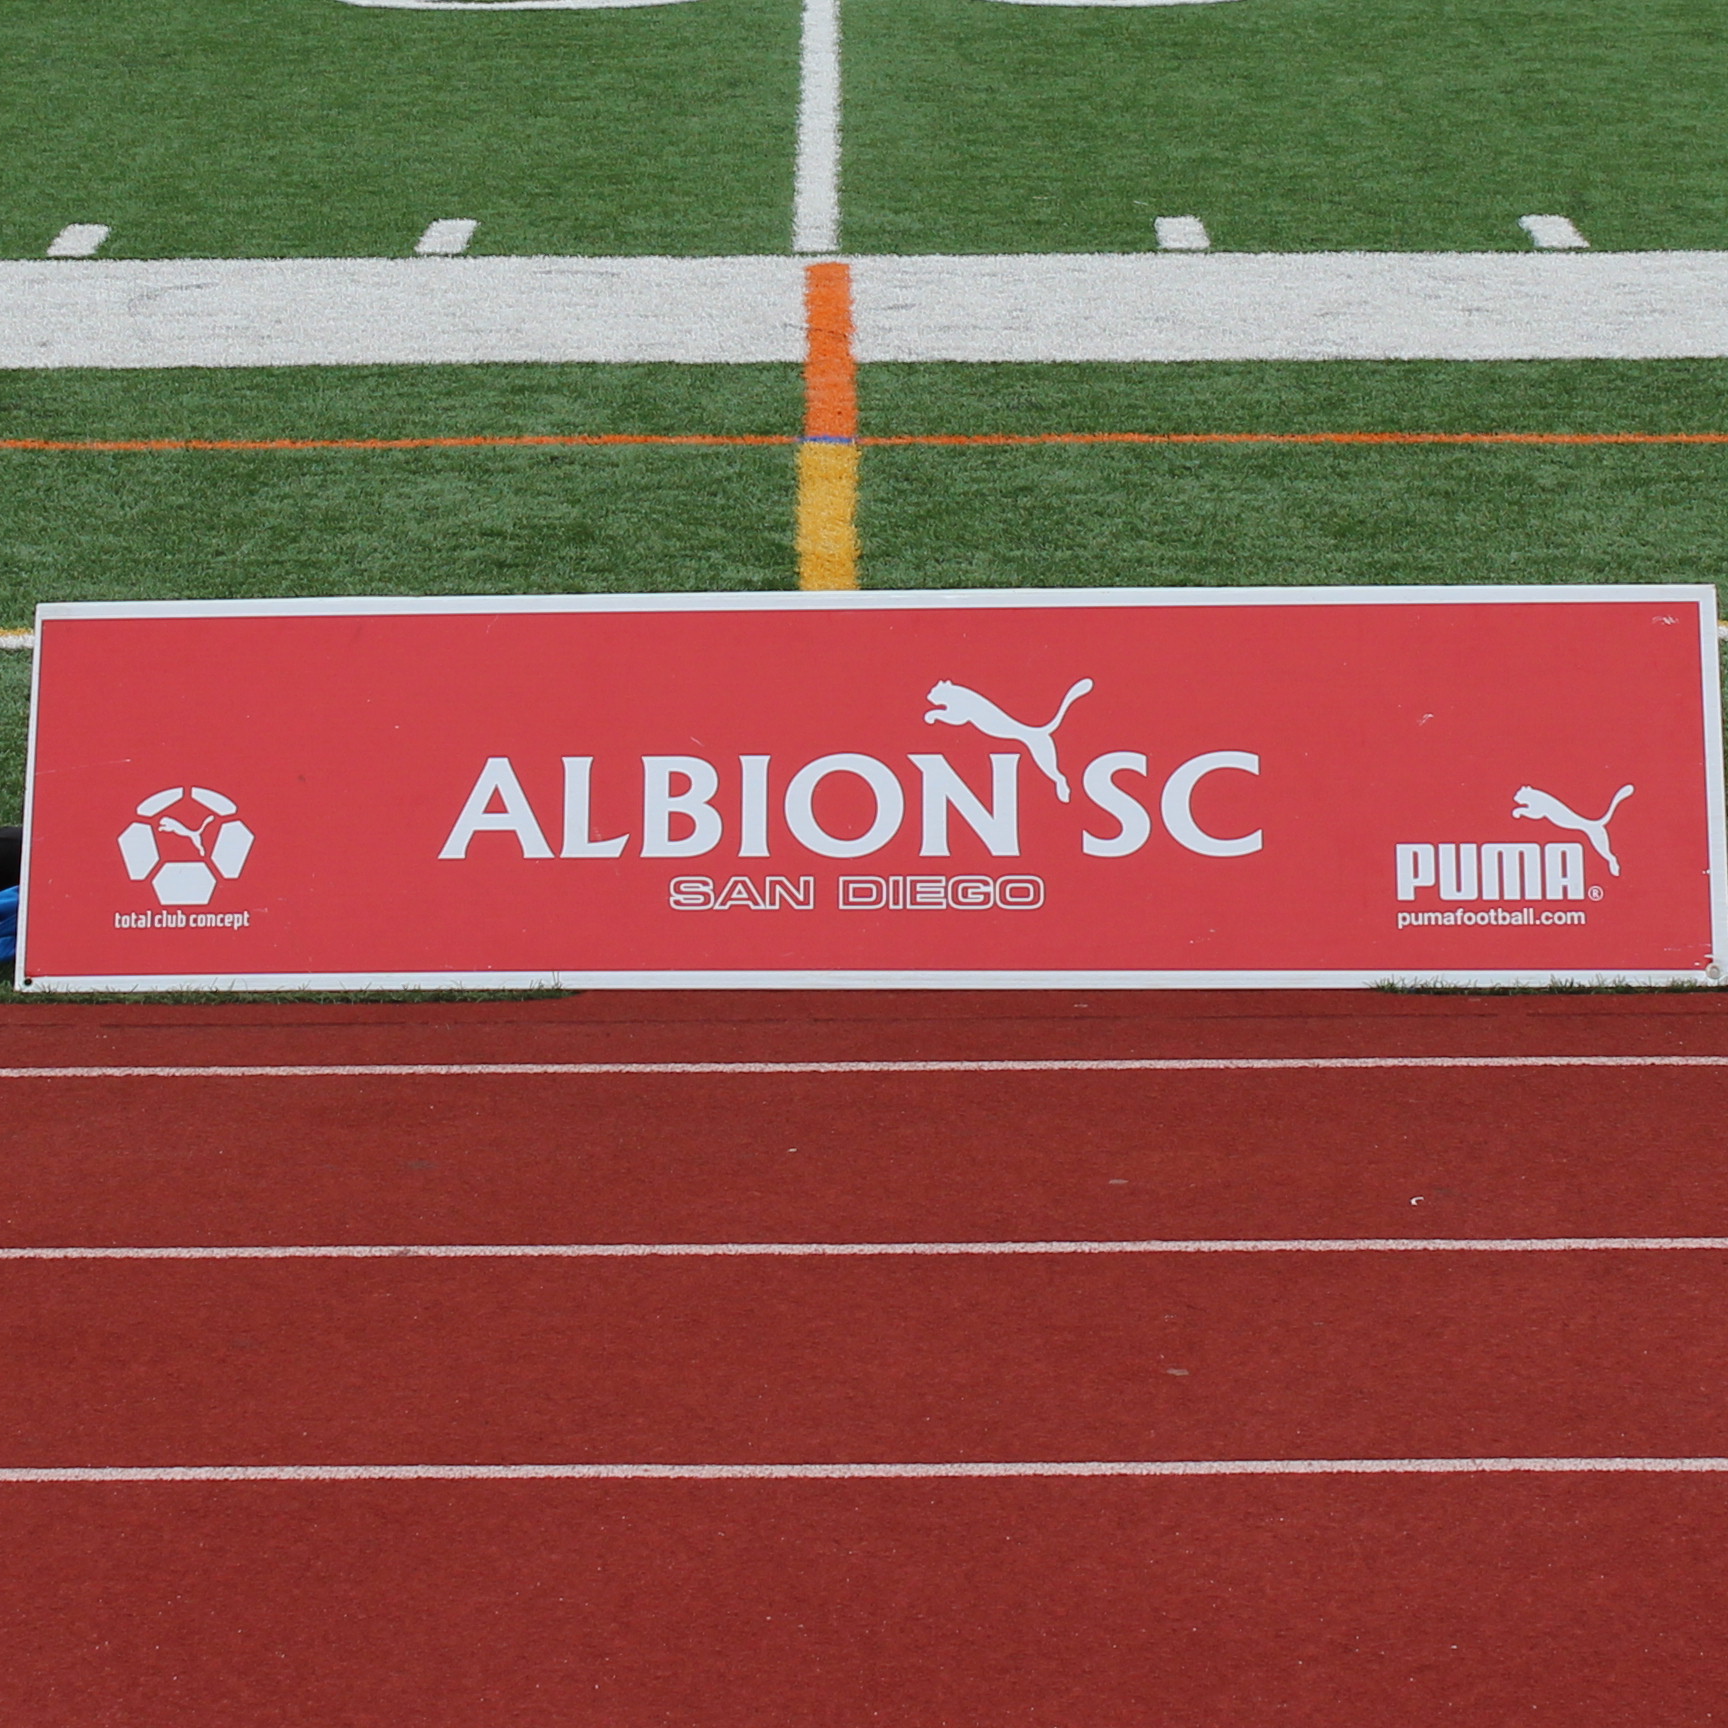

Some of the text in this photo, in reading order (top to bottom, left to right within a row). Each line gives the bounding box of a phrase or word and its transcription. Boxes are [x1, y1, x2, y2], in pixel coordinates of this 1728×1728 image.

[437, 750, 1264, 860] ALBION SC
[1395, 843, 1586, 901] PUMA
[668, 874, 1045, 910] SAN DIEGO
[114, 909, 250, 931] total club concept
[1397, 907, 1586, 929] pumafootball.com
